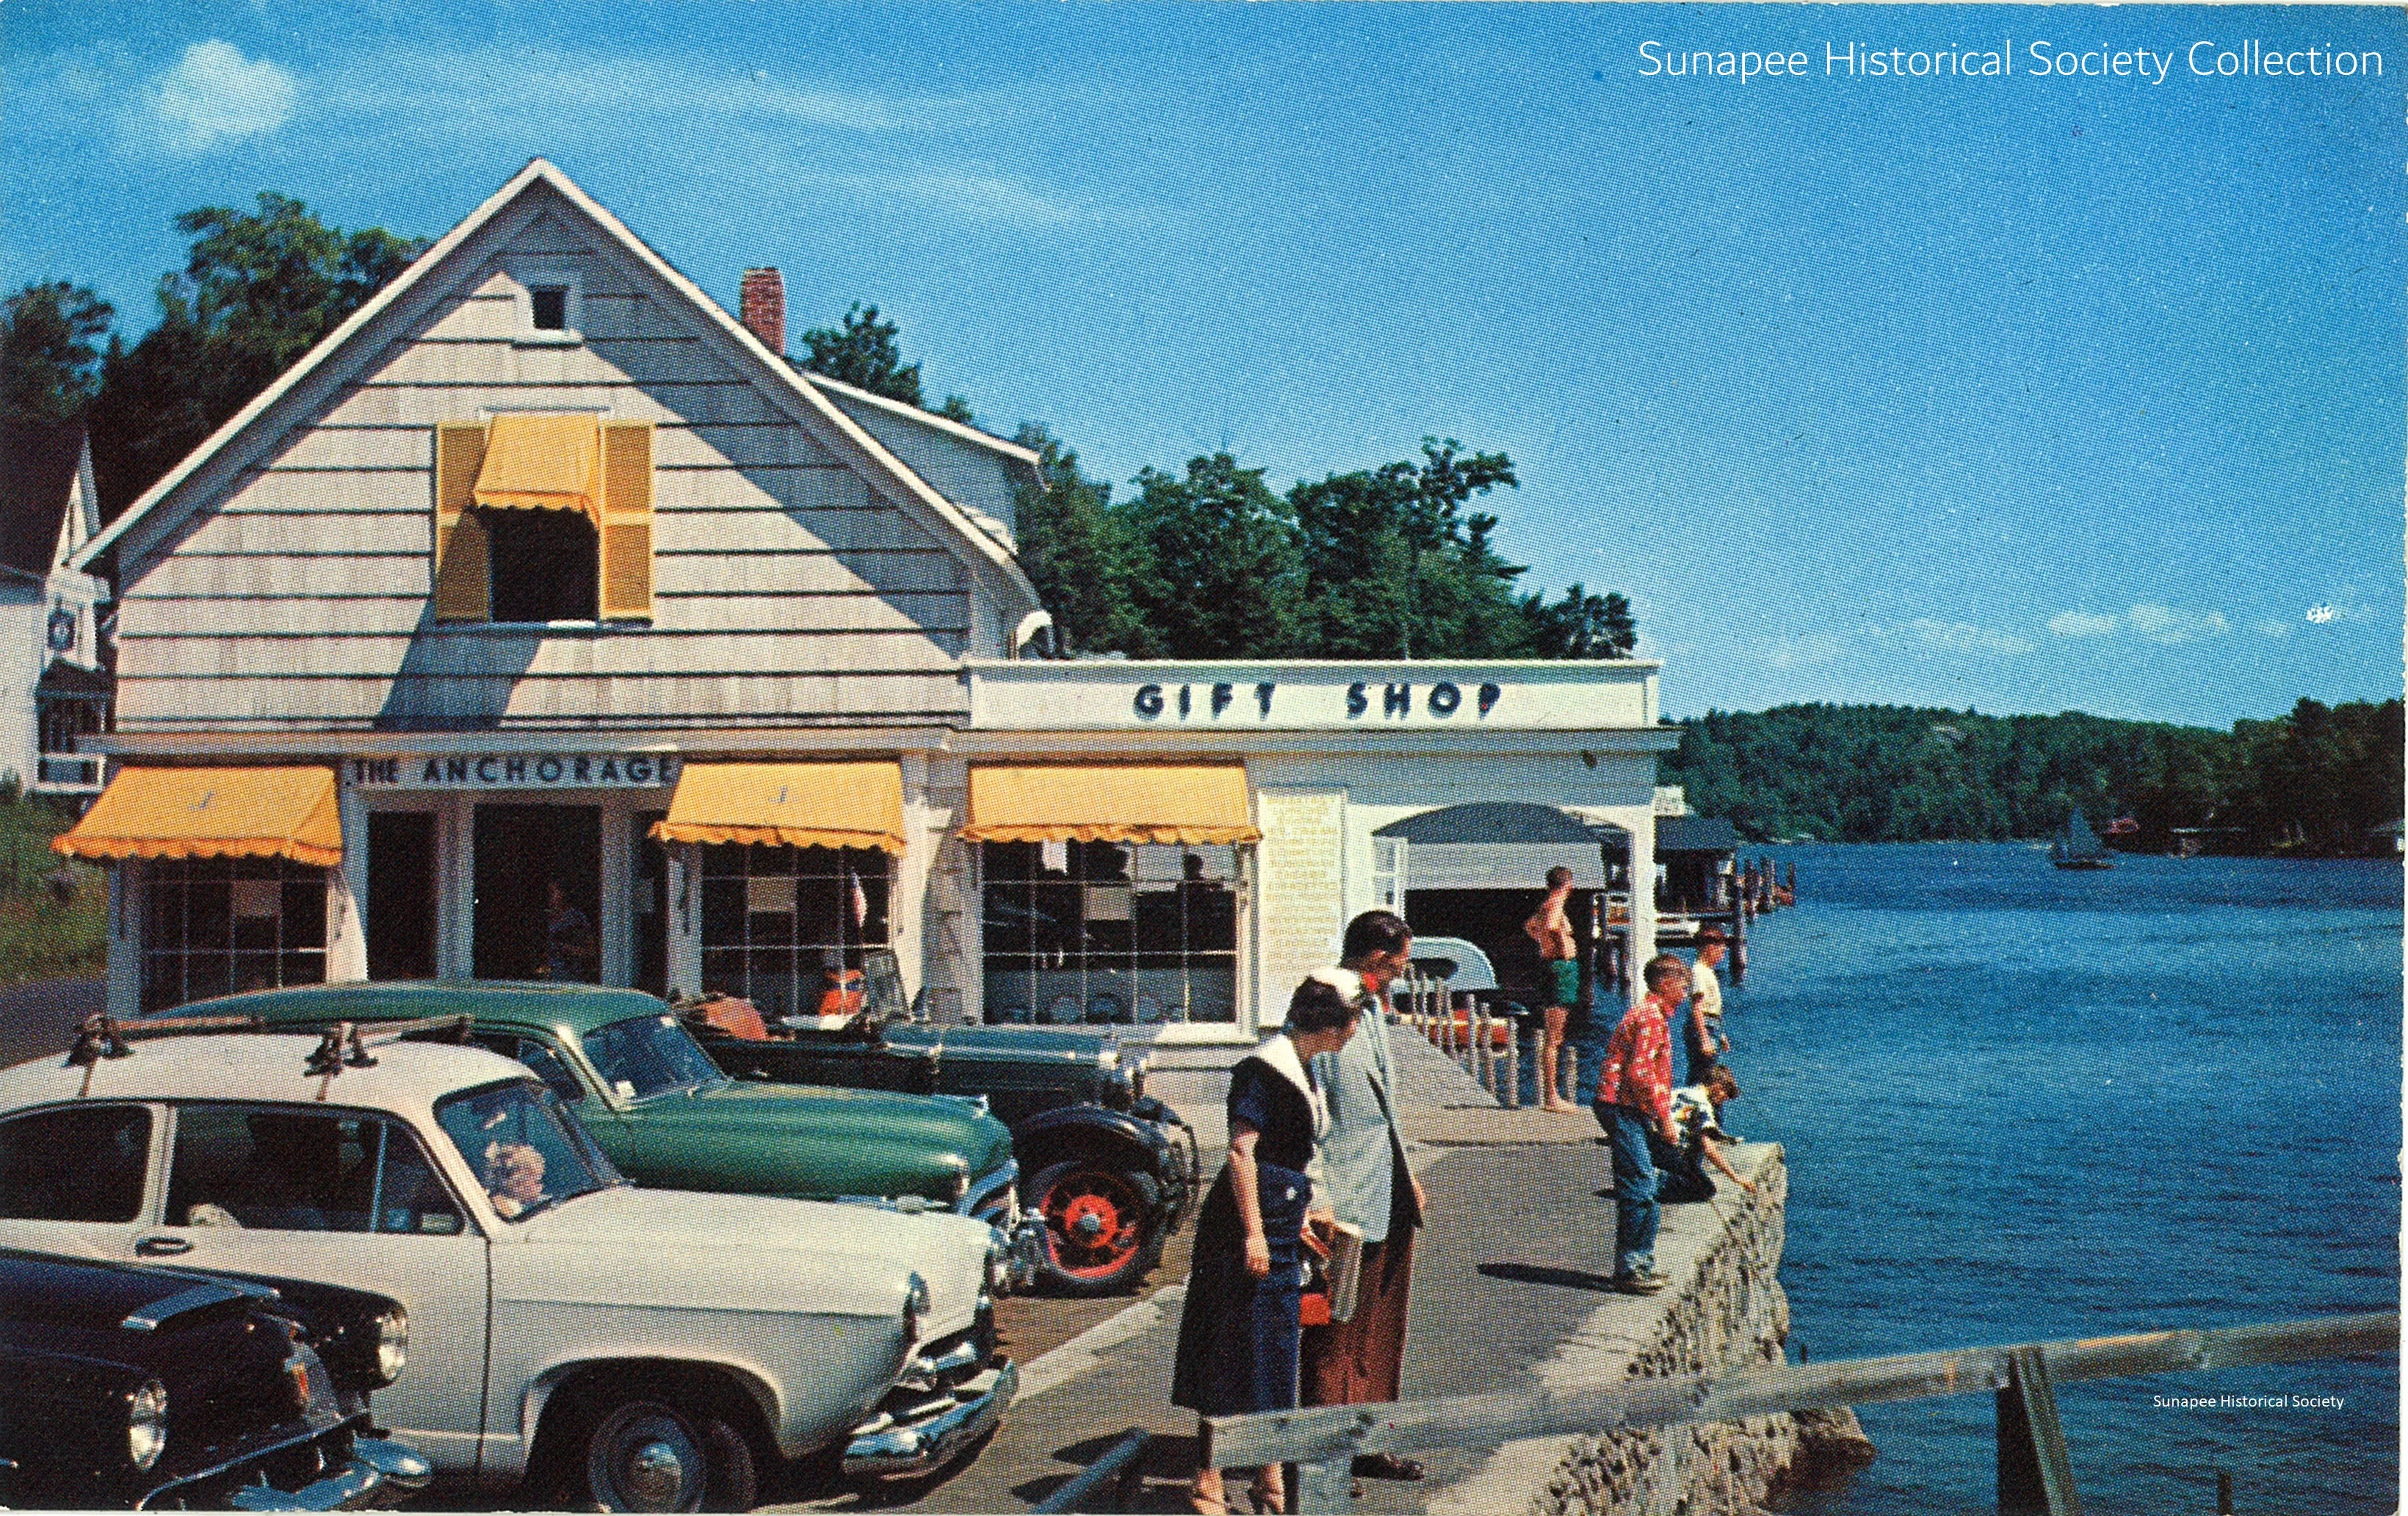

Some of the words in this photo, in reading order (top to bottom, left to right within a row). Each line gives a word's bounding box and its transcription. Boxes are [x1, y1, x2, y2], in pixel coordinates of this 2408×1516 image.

[1133, 682, 1276, 721] GIFT
[1346, 682, 1501, 721] SHOP
[355, 757, 398, 783] THE
[422, 757, 681, 783] ANCHORAGE
